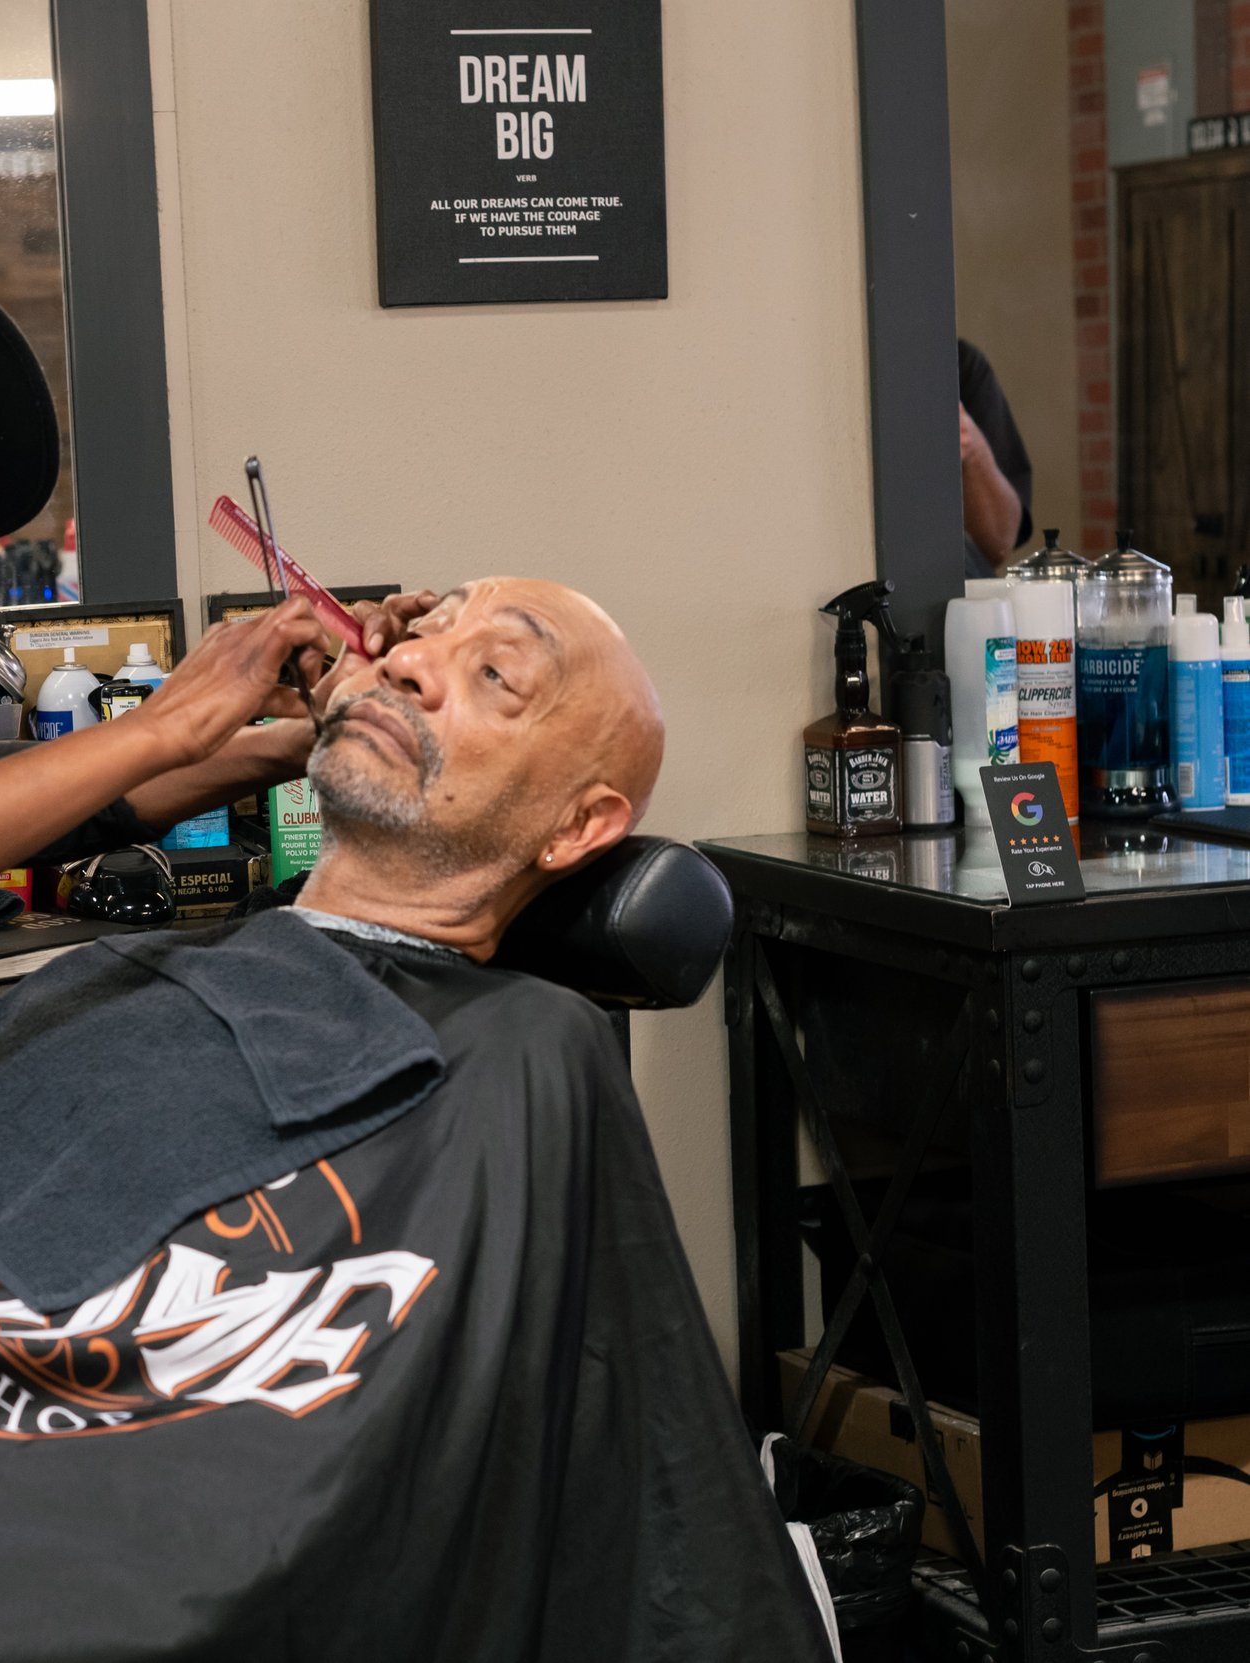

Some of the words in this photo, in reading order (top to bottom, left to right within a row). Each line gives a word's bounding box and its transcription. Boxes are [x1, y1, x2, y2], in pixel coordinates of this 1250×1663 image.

[459, 54, 587, 104] DREAM
[495, 111, 555, 160] BIG
[516, 174, 538, 182] VERB
[430, 200, 451, 210] ALL
[453, 199, 478, 210] OUR
[481, 198, 528, 209] DREAMS
[530, 197, 554, 208] CAN
[556, 197, 588, 207] COME
[591, 196, 623, 207] TRUE.
[454, 213, 467, 223] IF
[469, 213, 487, 223] WE
[490, 212, 520, 223] HAVE
[523, 212, 545, 222] THE
[547, 211, 601, 221] COURAGE
[480, 226, 496, 237] TO
[498, 226, 543, 236] PURSUE
[545, 225, 577, 235] THEM
[1018, 686, 1072, 701] CLIPPERCIDE
[1027, 773, 1045, 781] Google
[810, 790, 830, 804] WATER
[851, 790, 888, 804] WATER
[283, 812, 320, 825] CLUBM
[285, 849, 308, 857] POLVO
[309, 848, 319, 856] FIN
[1023, 846, 1035, 854] Your
[1035, 845, 1062, 853] Experience
[180, 872, 234, 887] ESPECIAL
[178, 888, 201, 896] NEGRA
[1112, 1485, 1146, 1497] streaming
[1147, 1481, 1165, 1490] video
[1118, 1530, 1147, 1541] delivery
[1148, 1526, 1163, 1535] free
